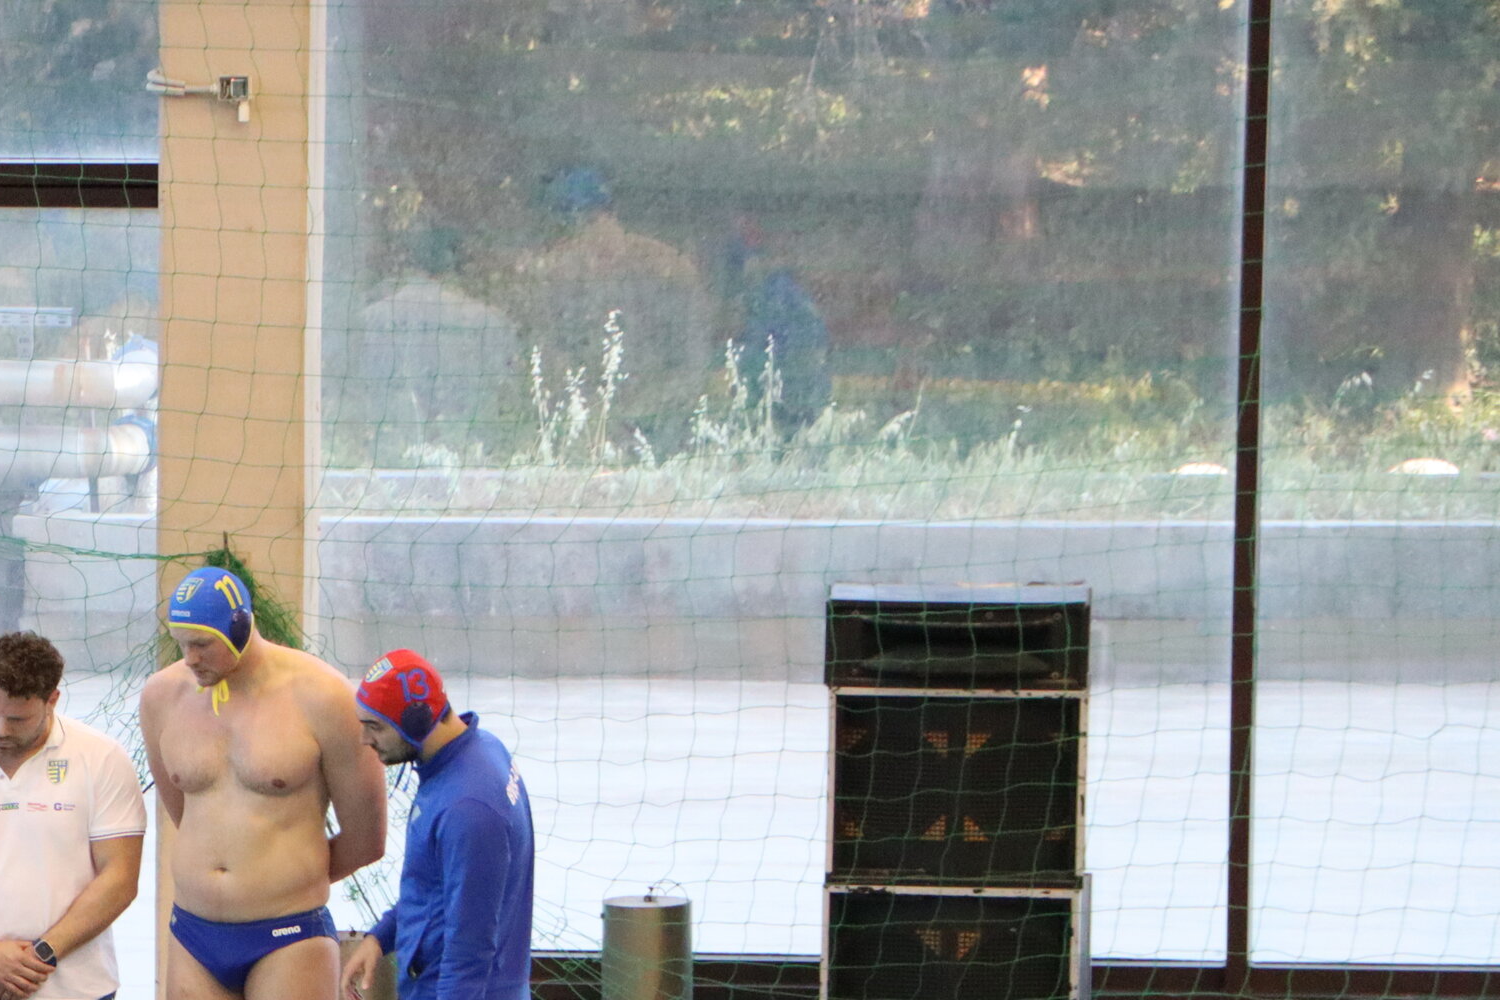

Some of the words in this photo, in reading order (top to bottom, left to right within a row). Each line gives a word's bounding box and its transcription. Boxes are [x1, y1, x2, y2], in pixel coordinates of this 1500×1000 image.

[214, 575, 243, 610] 11
[396, 668, 430, 702] 13
[272, 925, 301, 937] arena
